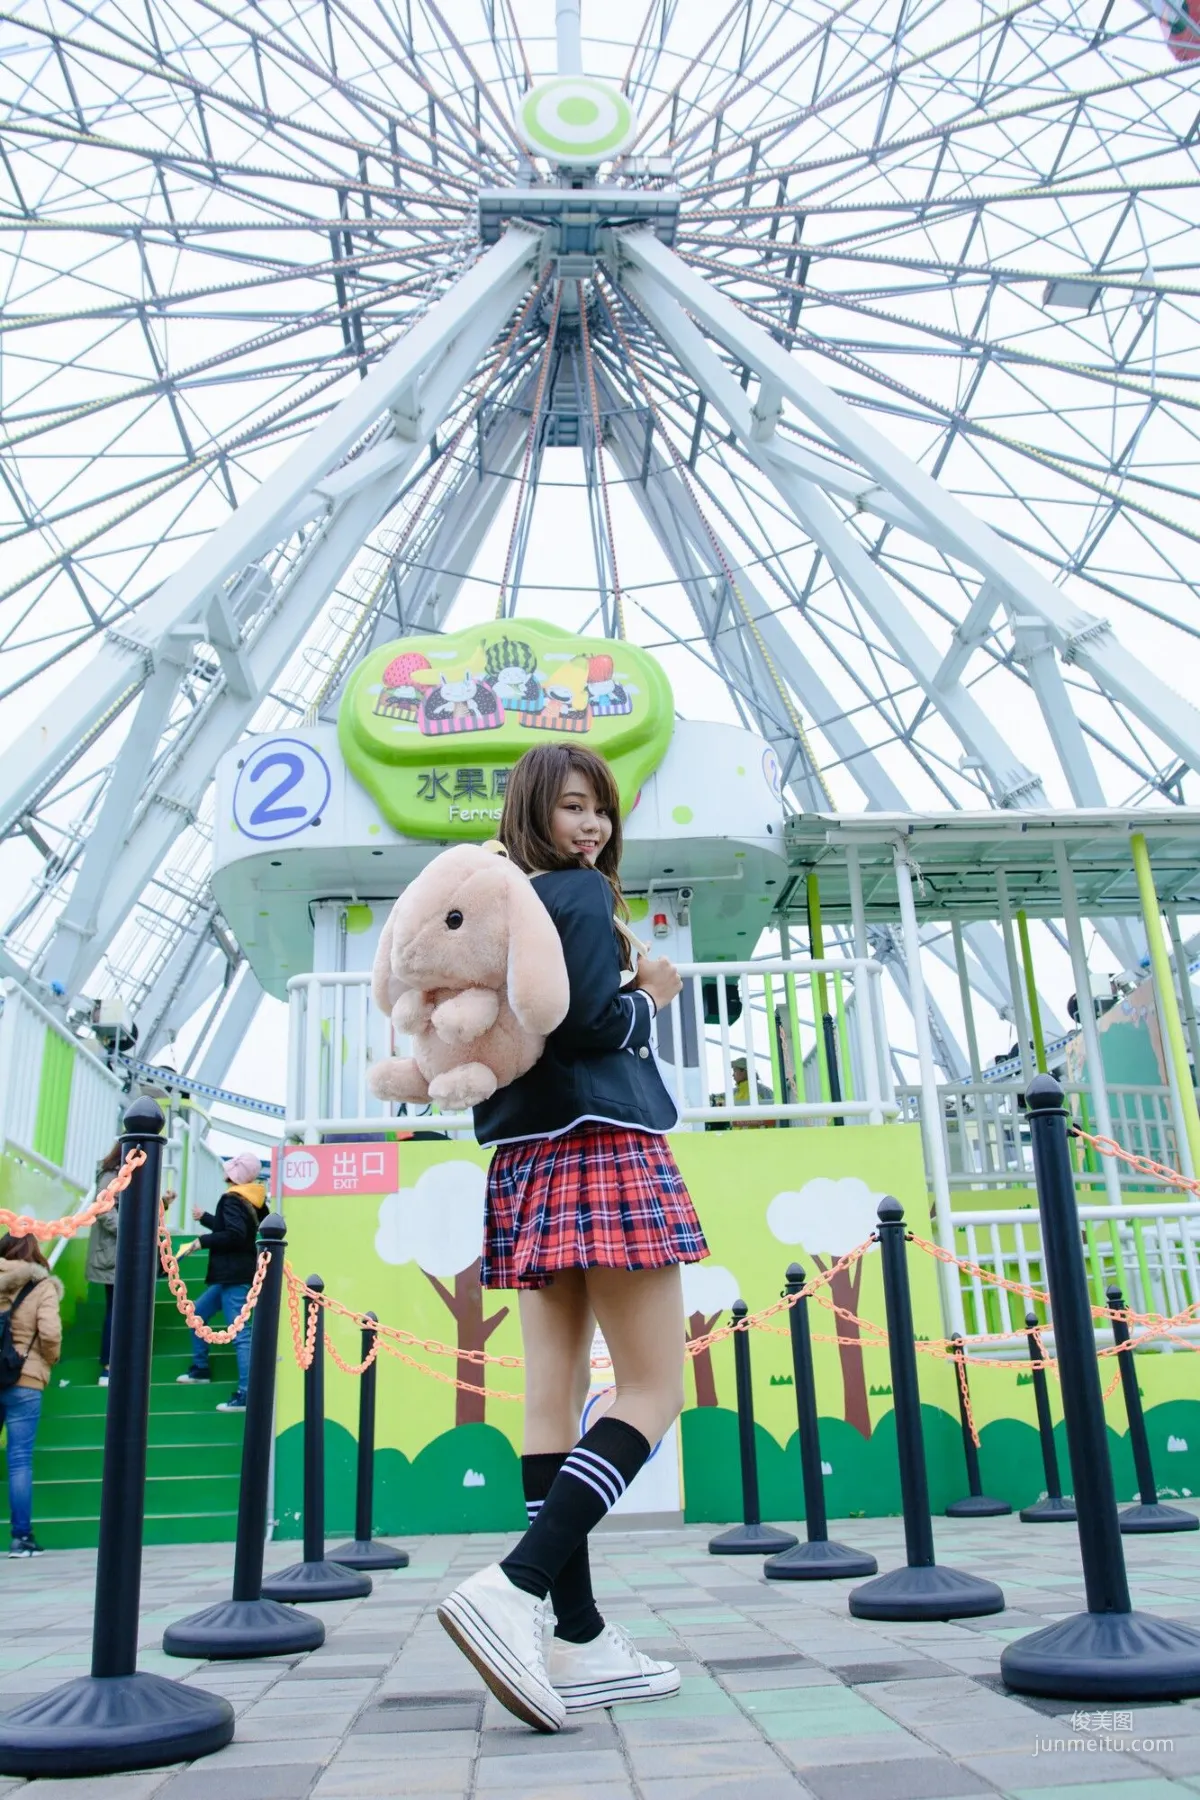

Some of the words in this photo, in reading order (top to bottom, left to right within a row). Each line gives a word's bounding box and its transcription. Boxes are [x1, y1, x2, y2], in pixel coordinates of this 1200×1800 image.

[249, 752, 308, 826] 2
[448, 805, 503, 822] Ferris
[286, 1160, 314, 1179] EXIT
[332, 1151, 384, 1177] 出口
[333, 1178, 358, 1190] EXIT
